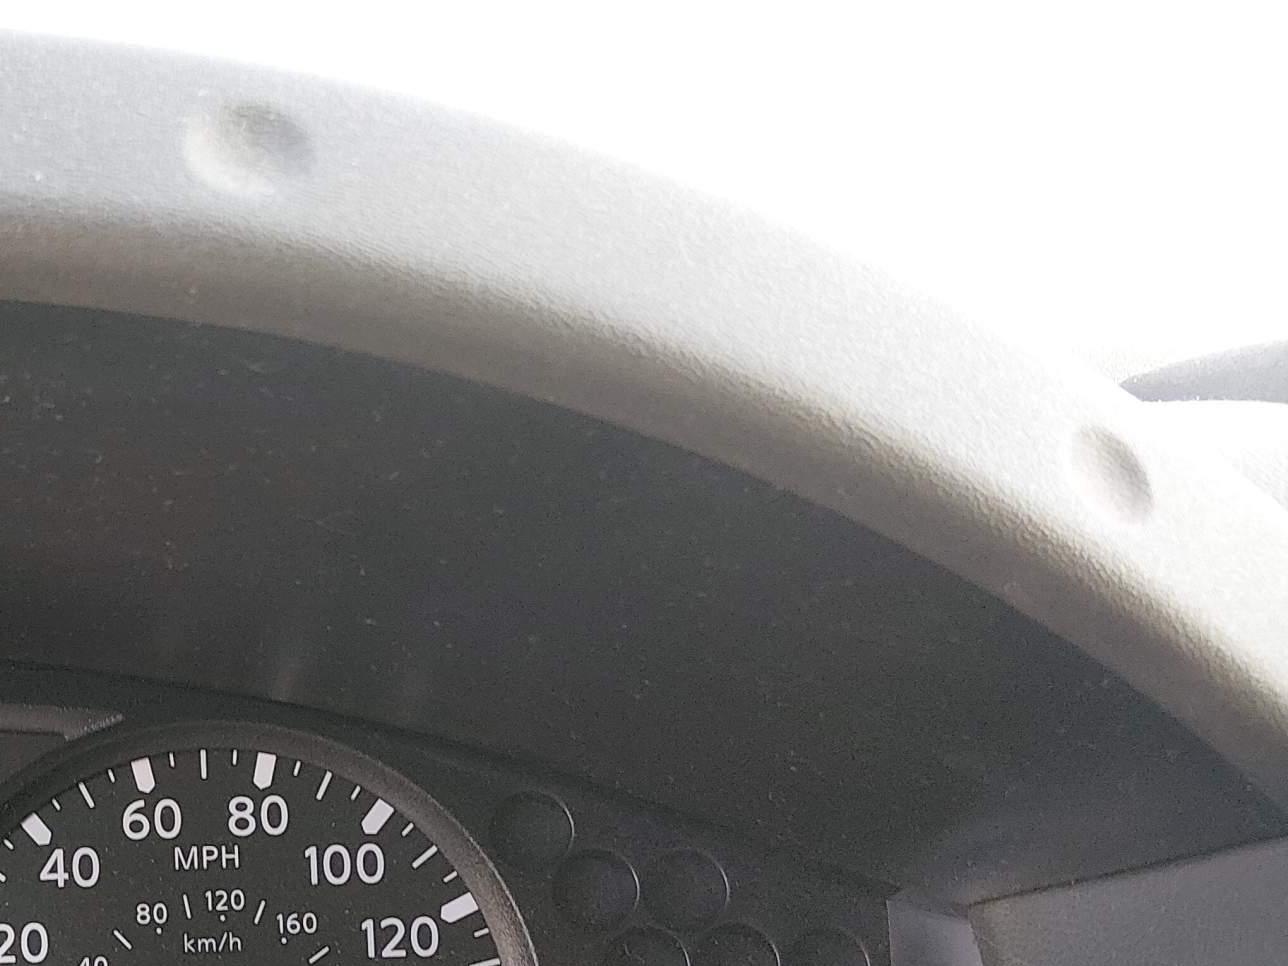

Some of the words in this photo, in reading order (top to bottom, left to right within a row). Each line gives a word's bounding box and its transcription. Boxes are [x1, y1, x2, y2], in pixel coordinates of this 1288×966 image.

[122, 799, 183, 840] 60
[227, 795, 289, 837] 80
[39, 847, 101, 888] 40
[173, 845, 241, 871] MPH
[304, 842, 386, 886] 100
[135, 902, 168, 925] 80
[204, 889, 246, 912] 120
[276, 913, 318, 935] 160
[361, 916, 440, 959] 120
[183, 932, 243, 954] km/h
